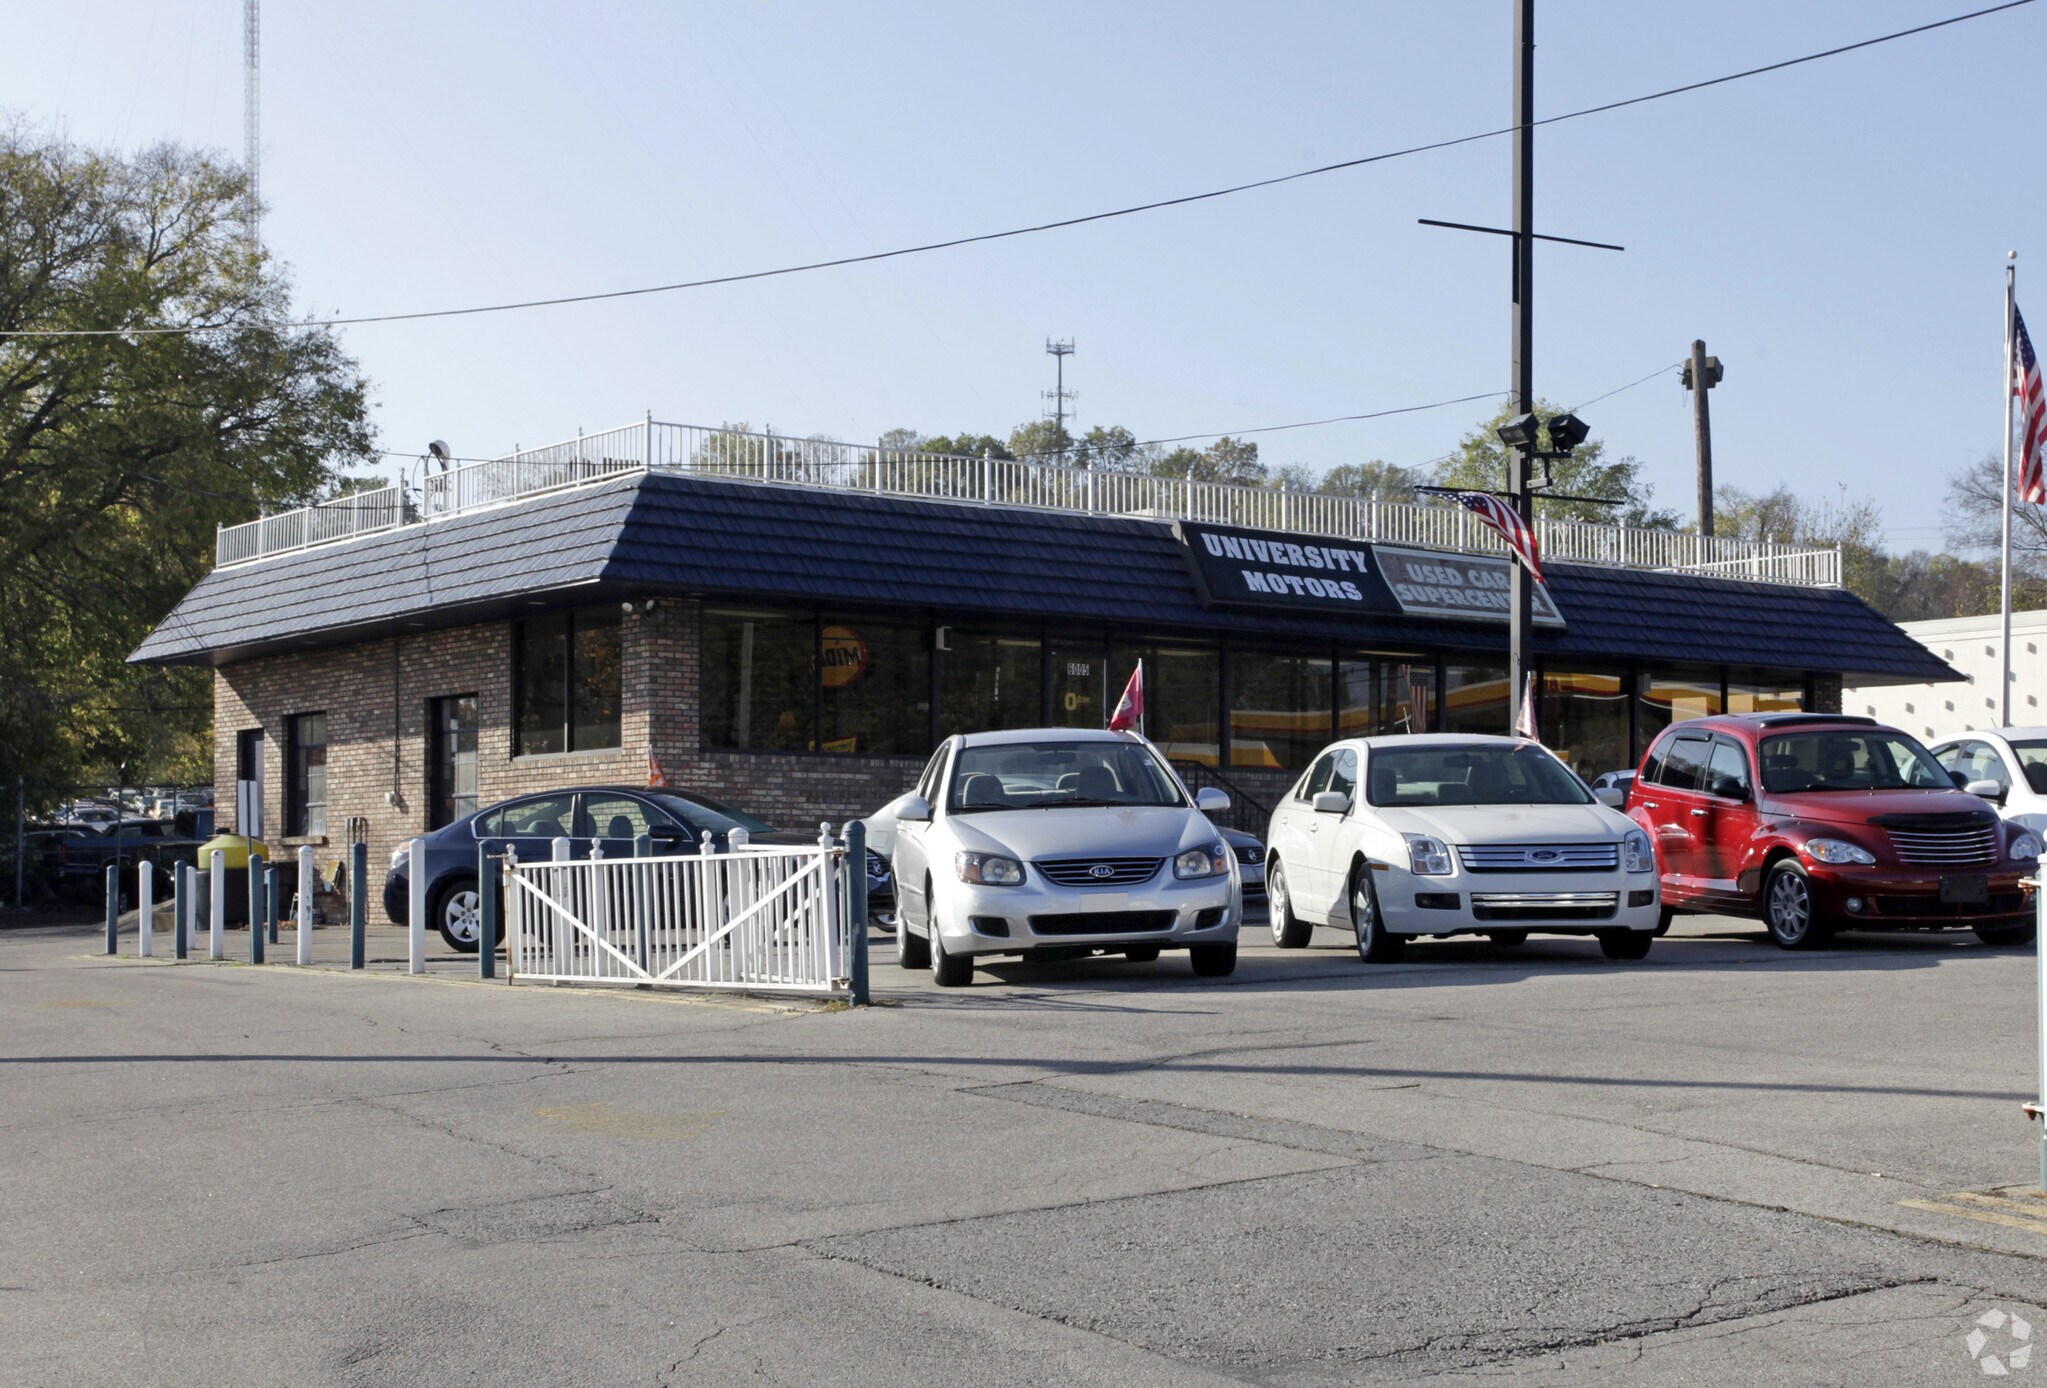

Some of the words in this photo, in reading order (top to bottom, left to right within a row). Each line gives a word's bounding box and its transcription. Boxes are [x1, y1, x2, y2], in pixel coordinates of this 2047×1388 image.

[1201, 533, 1367, 573] UNIVERSITY
[1241, 570, 1363, 600] MOTORS
[1406, 563, 1463, 586] USED
[1468, 569, 1511, 590] CAR
[1396, 584, 1546, 612] SUPERCENTR
[1067, 662, 1090, 676] 6005
[1094, 867, 1110, 875] KIA
